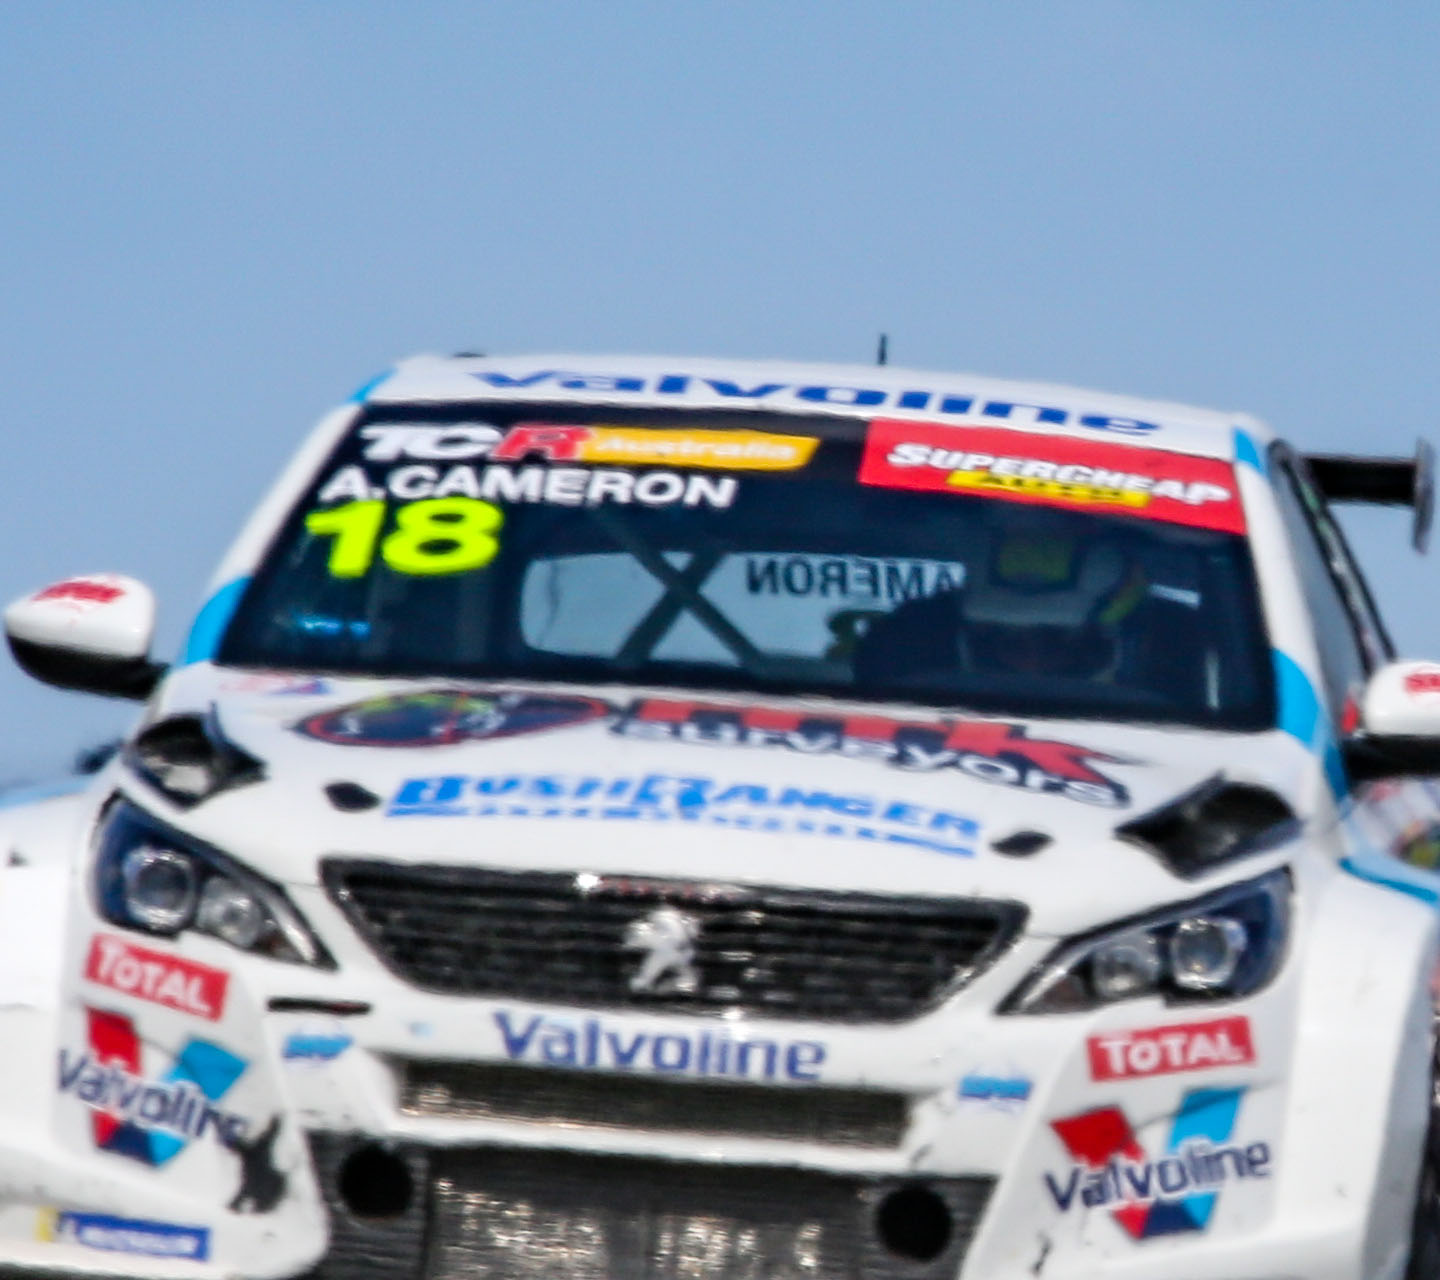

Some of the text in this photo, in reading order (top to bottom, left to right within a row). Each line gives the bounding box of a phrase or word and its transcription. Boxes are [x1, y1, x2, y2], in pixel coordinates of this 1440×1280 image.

[360, 424, 594, 462] TCR
[886, 441, 1233, 506] SUPERCHEAP
[317, 463, 739, 508] A.CAMERON
[306, 496, 505, 579] 18
[493, 1010, 829, 1083] Valvoline
[1100, 1029, 1246, 1076] TOTAL
[1043, 1140, 1272, 1212] Valvoline
